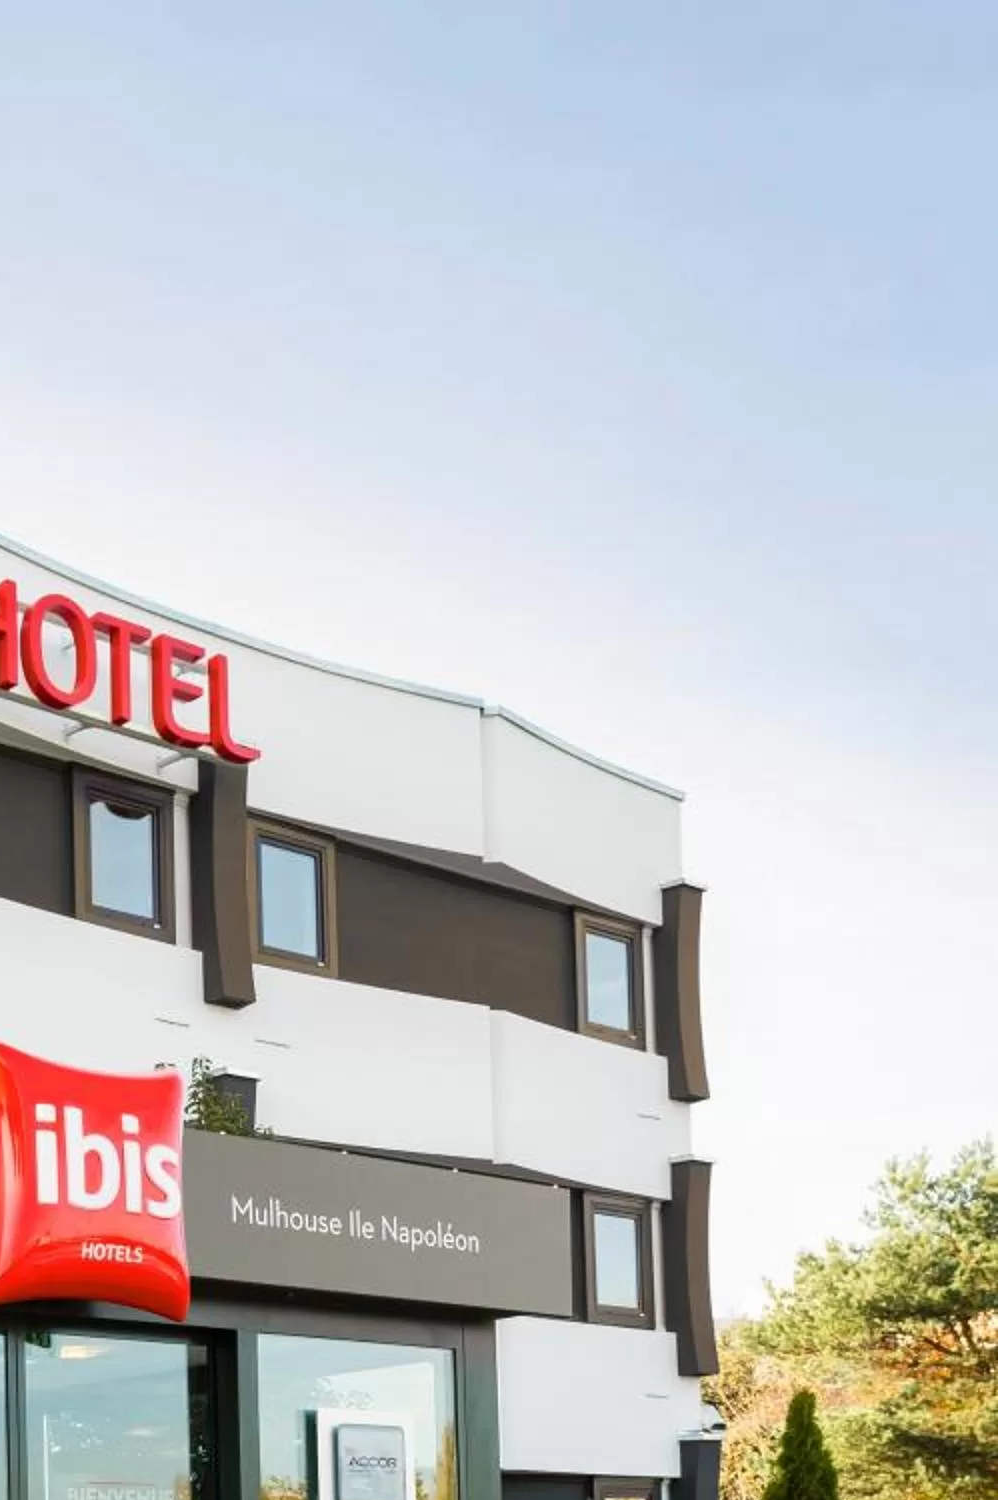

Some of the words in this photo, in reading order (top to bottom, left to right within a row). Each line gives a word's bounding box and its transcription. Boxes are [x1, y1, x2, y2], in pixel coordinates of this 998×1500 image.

[34, 1103, 181, 1219] ibis
[231, 1194, 343, 1235] Mulhouse
[349, 1209, 374, 1239] Ile
[381, 1215, 479, 1253] Napoléon
[81, 1241, 143, 1263] HOTELS
[349, 1456, 398, 1469] ACCOR
